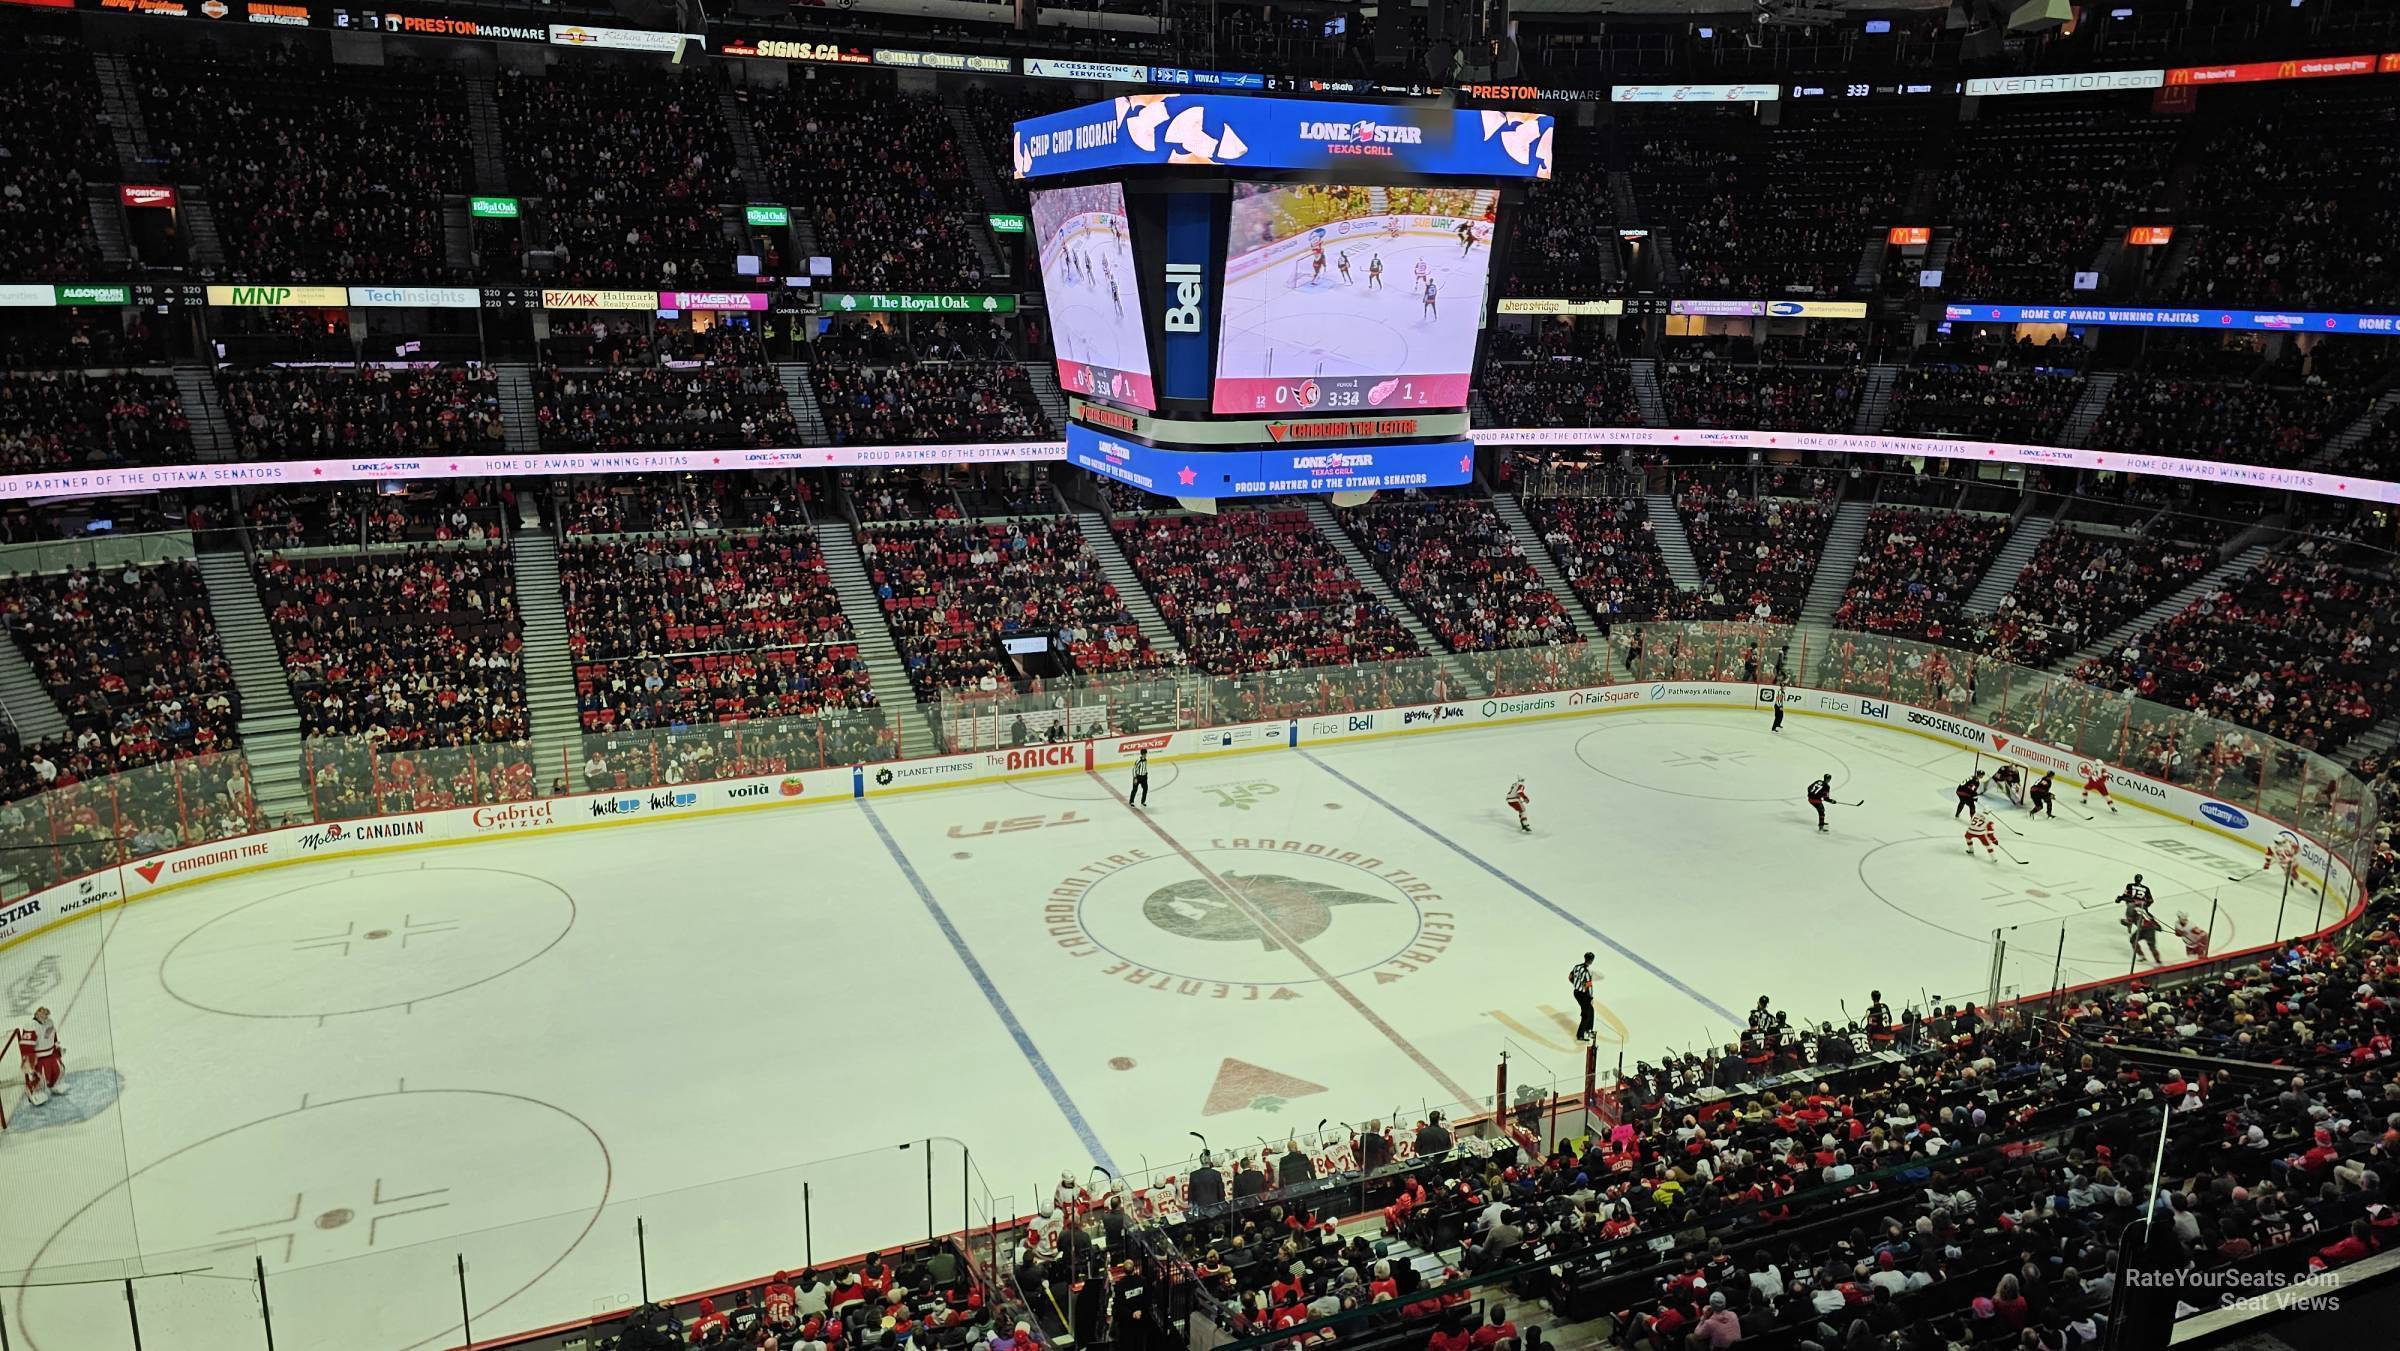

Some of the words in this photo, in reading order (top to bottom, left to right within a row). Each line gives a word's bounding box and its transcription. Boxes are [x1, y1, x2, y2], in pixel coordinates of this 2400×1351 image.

[757, 40, 839, 61] SIGNS.CA
[1053, 62, 1087, 71] ACCESS
[1090, 65, 1128, 73] RIGGING
[1070, 70, 1113, 79] SERVICES
[1332, 82, 1354, 91] skate
[1030, 133, 1049, 158] CHIP
[1053, 129, 1073, 154] CHIP
[1075, 119, 1117, 150] HOORAY!
[1299, 121, 1352, 141] LONE
[1373, 125, 1422, 144] STAR
[1328, 144, 1362, 155] TEXAS
[1364, 145, 1393, 156] GRILL
[182, 285, 202, 294] 320
[232, 287, 291, 305] MNP
[364, 289, 466, 305] TechInsights
[484, 289, 501, 297] 320
[523, 289, 539, 297] 321
[603, 292, 655, 302] Hallmark
[184, 297, 203, 305] 220
[485, 300, 502, 308] 220
[524, 300, 539, 308] 221
[545, 291, 599, 307] RE/MAX
[690, 294, 751, 305] MAGENTA
[869, 294, 898, 309] The
[900, 294, 943, 312] Royal
[945, 294, 970, 309] Oak
[1165, 263, 1201, 333] Bell
[2020, 309, 2050, 320] HOME
[2053, 310, 2067, 320] OF
[2070, 310, 2106, 321] AWARD
[2109, 311, 2154, 322] WINNING
[2157, 312, 2200, 323] FAJITAS
[2358, 318, 2393, 330] HOME
[1275, 385, 1288, 404] 0
[1403, 382, 1413, 400] 1
[1291, 421, 1349, 438] CANADIAN
[1378, 419, 1417, 436] CENTRE
[1553, 432, 1570, 440] THE
[1572, 432, 1606, 440] OTTAWA
[1609, 432, 1653, 440] SENATORS
[857, 451, 890, 460] PROUD
[894, 450, 937, 459] PARTNER
[941, 449, 953, 458] OF
[957, 449, 974, 457] THE
[978, 448, 1016, 457] OTTAWA
[1019, 446, 1067, 456] SENATORS
[1796, 437, 1824, 446] HOME
[1827, 438, 1839, 446] OF
[1843, 439, 1877, 448] AWARD
[1880, 440, 1923, 450] WINNING
[1927, 442, 1966, 453] FAJITAS
[486, 461, 519, 470] HOME
[524, 460, 538, 469] OF
[544, 459, 585, 468] AWARD
[591, 458, 640, 467] WINNING
[644, 456, 688, 466] FAJITAS
[1293, 456, 1328, 469] LONE
[1341, 454, 1374, 467] STAR
[2052, 451, 2073, 459] STAR
[394, 462, 420, 470] STAR
[2127, 459, 2156, 469] HOME
[2161, 461, 2175, 471] OF
[2178, 461, 2215, 475] AWARD
[2219, 466, 2266, 481] WINNING
[2270, 473, 2314, 487] FAJITAS
[26, 477, 89, 490] PARTNER
[96, 475, 112, 487] OF
[119, 473, 145, 486] THE
[152, 470, 208, 483] OTTAWA
[214, 468, 282, 480] SENATORS
[1235, 481, 1267, 493] PROUD
[1269, 479, 1308, 491] PARTNER
[1311, 478, 1324, 489] OF
[1325, 477, 1343, 489] THE
[1345, 475, 1381, 487] OTTAWA
[1383, 473, 1427, 485] SENATORS
[1585, 690, 1640, 704] FairSquare
[1667, 687, 1701, 697] Pathways
[1702, 687, 1732, 696] Alliance
[1500, 697, 1557, 714] Desjardins
[1820, 697, 1850, 712] Fibe
[1860, 700, 1889, 720] Bell
[1312, 721, 1338, 735] Fibe
[1349, 714, 1374, 732] Bell
[1404, 712, 1433, 724] Booster
[1907, 711, 1986, 744] 5050SENS.COM
[986, 754, 1005, 766] The
[1007, 746, 1074, 771] BRICK
[2010, 744, 2051, 767] CANADIAN
[2052, 757, 2070, 772] TIRE
[897, 766, 934, 778] PLANET
[935, 762, 973, 774] FITNESS
[2116, 776, 2167, 799] CANADA
[473, 800, 553, 828] Gabriel
[499, 818, 554, 830] PIZZA
[298, 829, 351, 850] Molson
[356, 821, 425, 840] CANADIAN
[171, 848, 237, 874] CANADIAN
[239, 842, 269, 858] TIRE
[1210, 837, 1384, 870] CANADIAN
[1080, 847, 1152, 877] TIRE
[1384, 867, 1445, 903] TIRE
[1387, 909, 1456, 974] CENTRE
